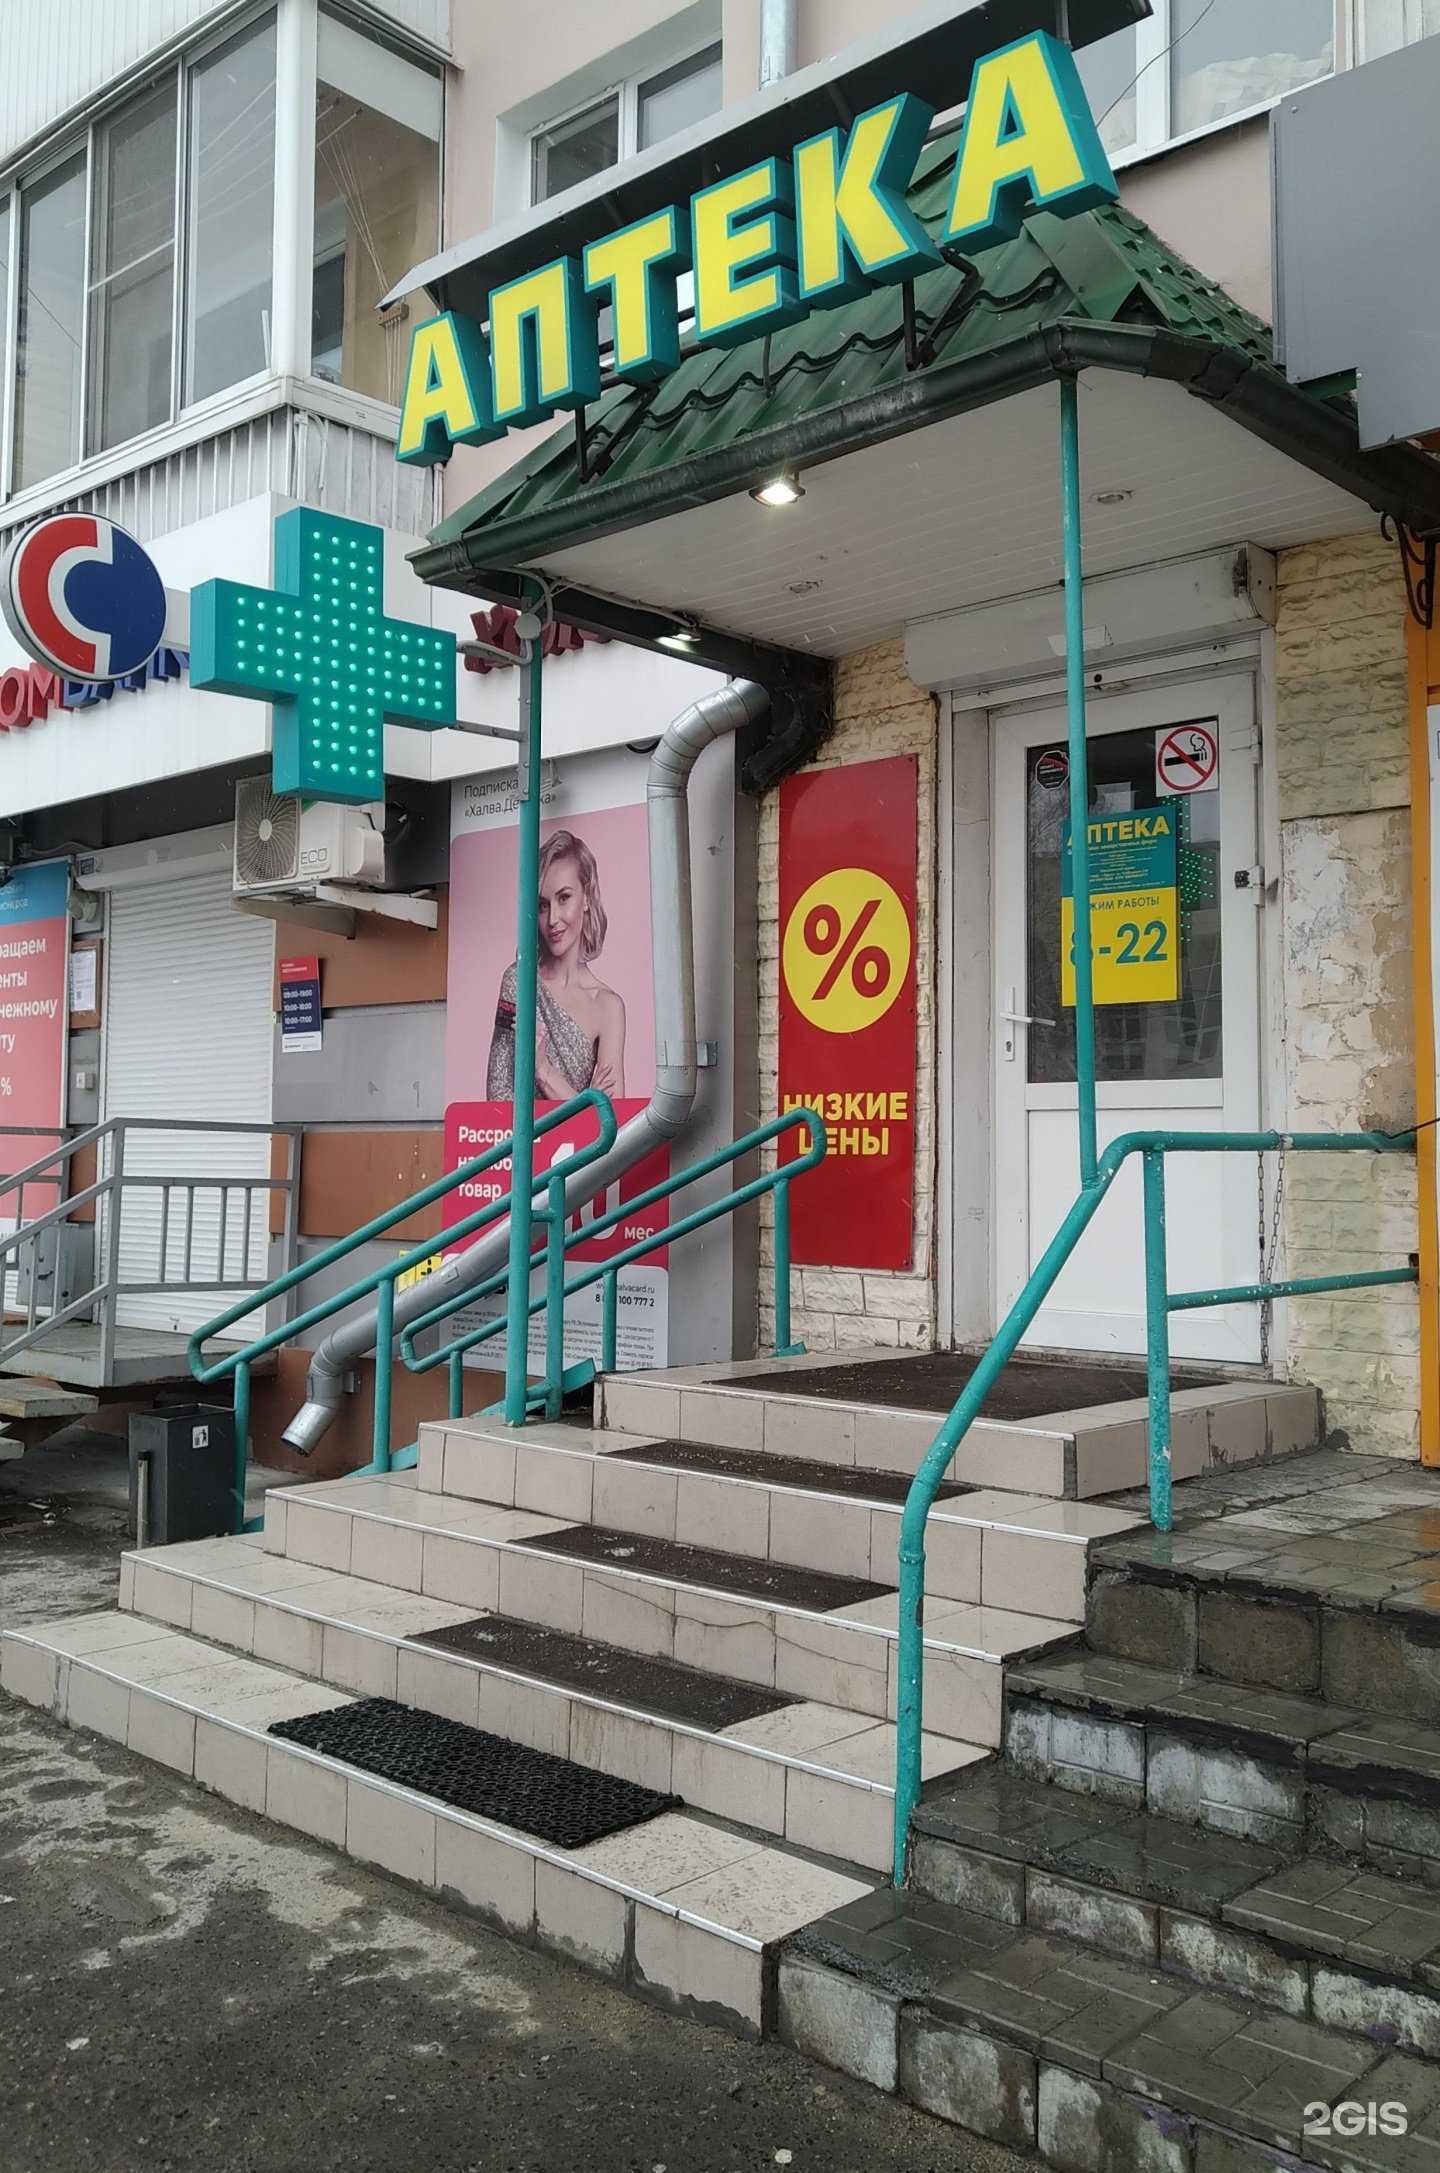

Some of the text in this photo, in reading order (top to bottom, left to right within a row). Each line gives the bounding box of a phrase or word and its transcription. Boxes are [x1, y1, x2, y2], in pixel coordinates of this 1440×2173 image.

[395, 28, 1120, 467] АПТЕКА
[464, 778, 519, 799] Подписка
[1067, 815, 1170, 847] ПТЕКА
[300, 847, 328, 865] ECO
[1117, 895, 1160, 909] РАБОТЫ
[0, 938, 46, 959] ащаем
[783, 1091, 908, 1121] НИЗКИЕ
[458, 1125, 542, 1147] Рассро
[458, 1182, 502, 1203] товар
[624, 1226, 655, 1241] мес
[618, 1295, 632, 1305] 100
[633, 1296, 648, 1306] 777
